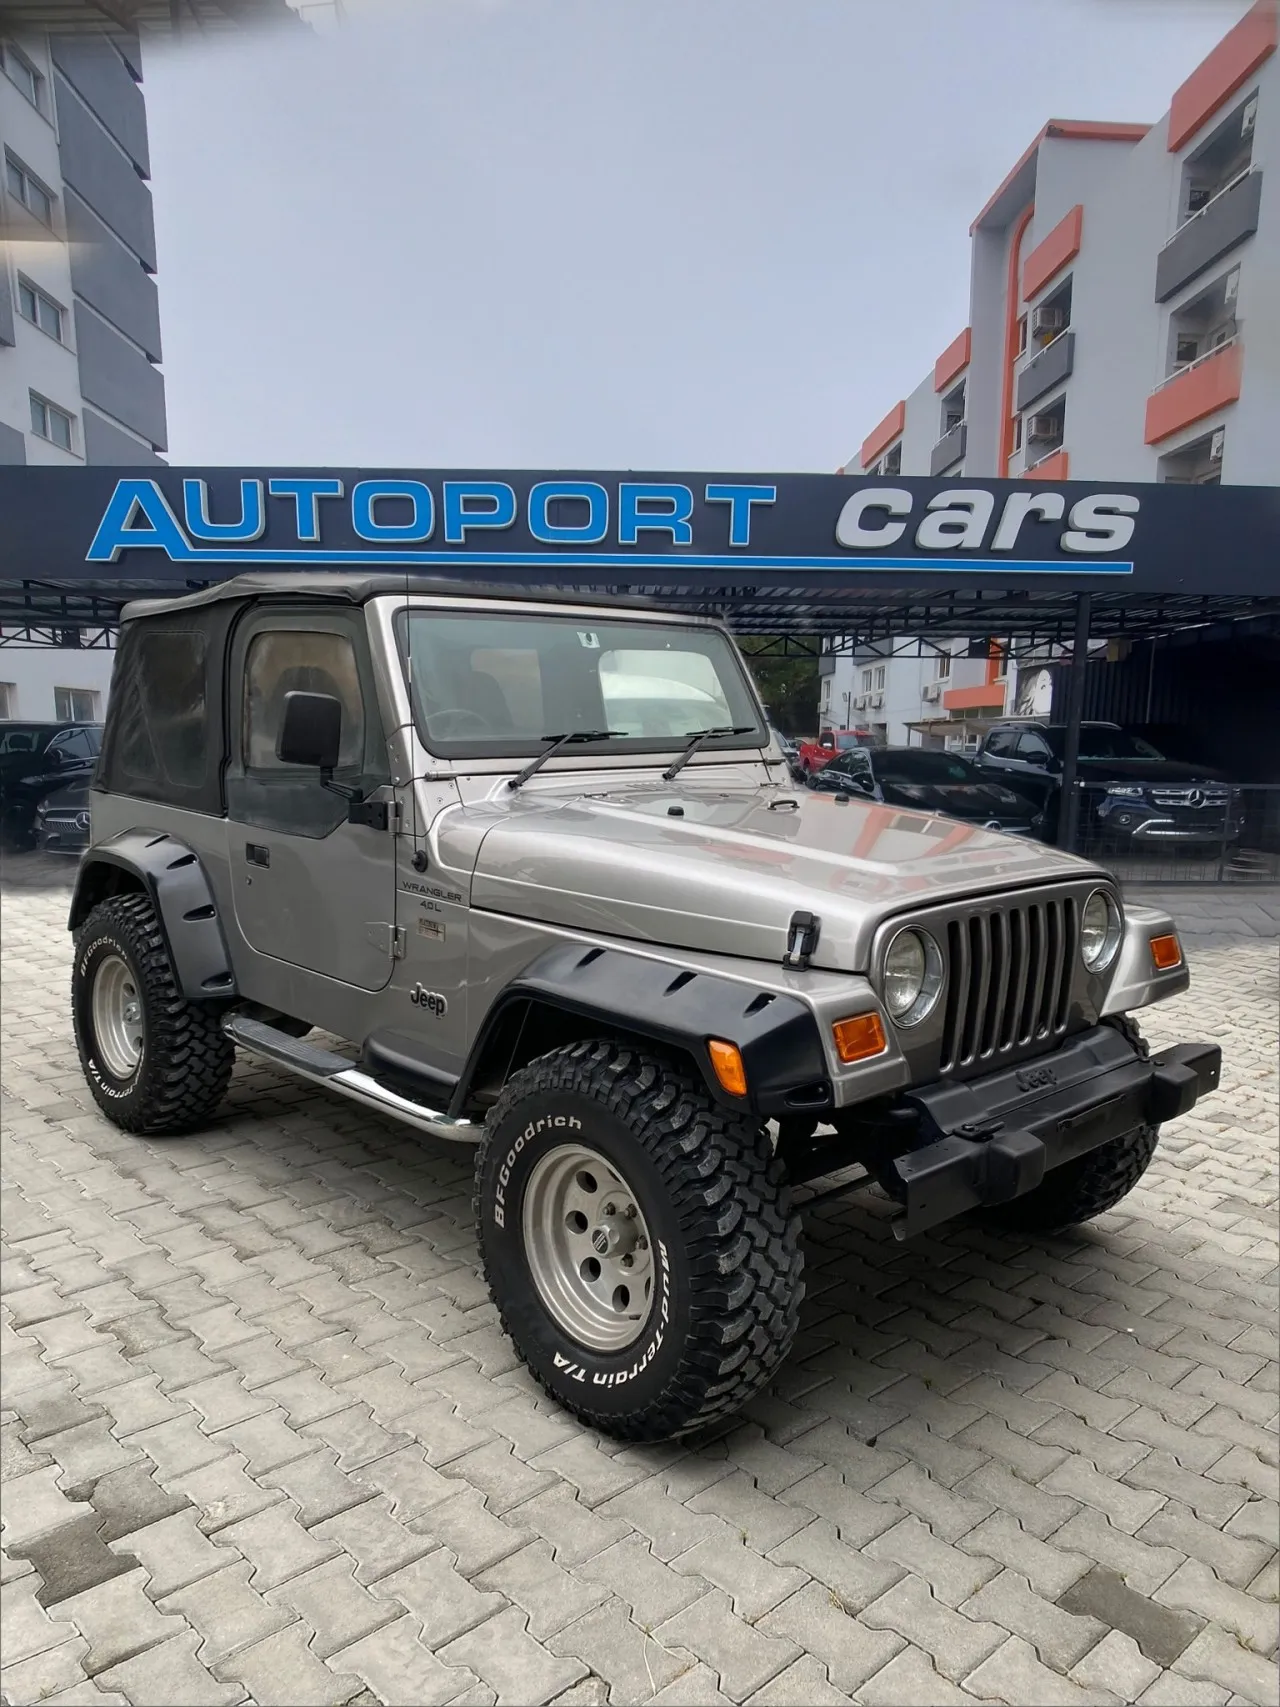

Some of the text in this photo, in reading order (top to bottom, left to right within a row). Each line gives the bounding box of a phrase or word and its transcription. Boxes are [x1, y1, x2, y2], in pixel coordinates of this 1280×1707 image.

[85, 478, 1141, 563] AUTOPORT cars
[402, 880, 462, 902] WRANGLER
[410, 982, 448, 1018] Jeep
[88, 1058, 102, 1083] T/A
[1015, 1068, 1057, 1092] Jeep
[494, 1114, 582, 1229] BFGoodrich
[552, 1351, 586, 1382] T/A
